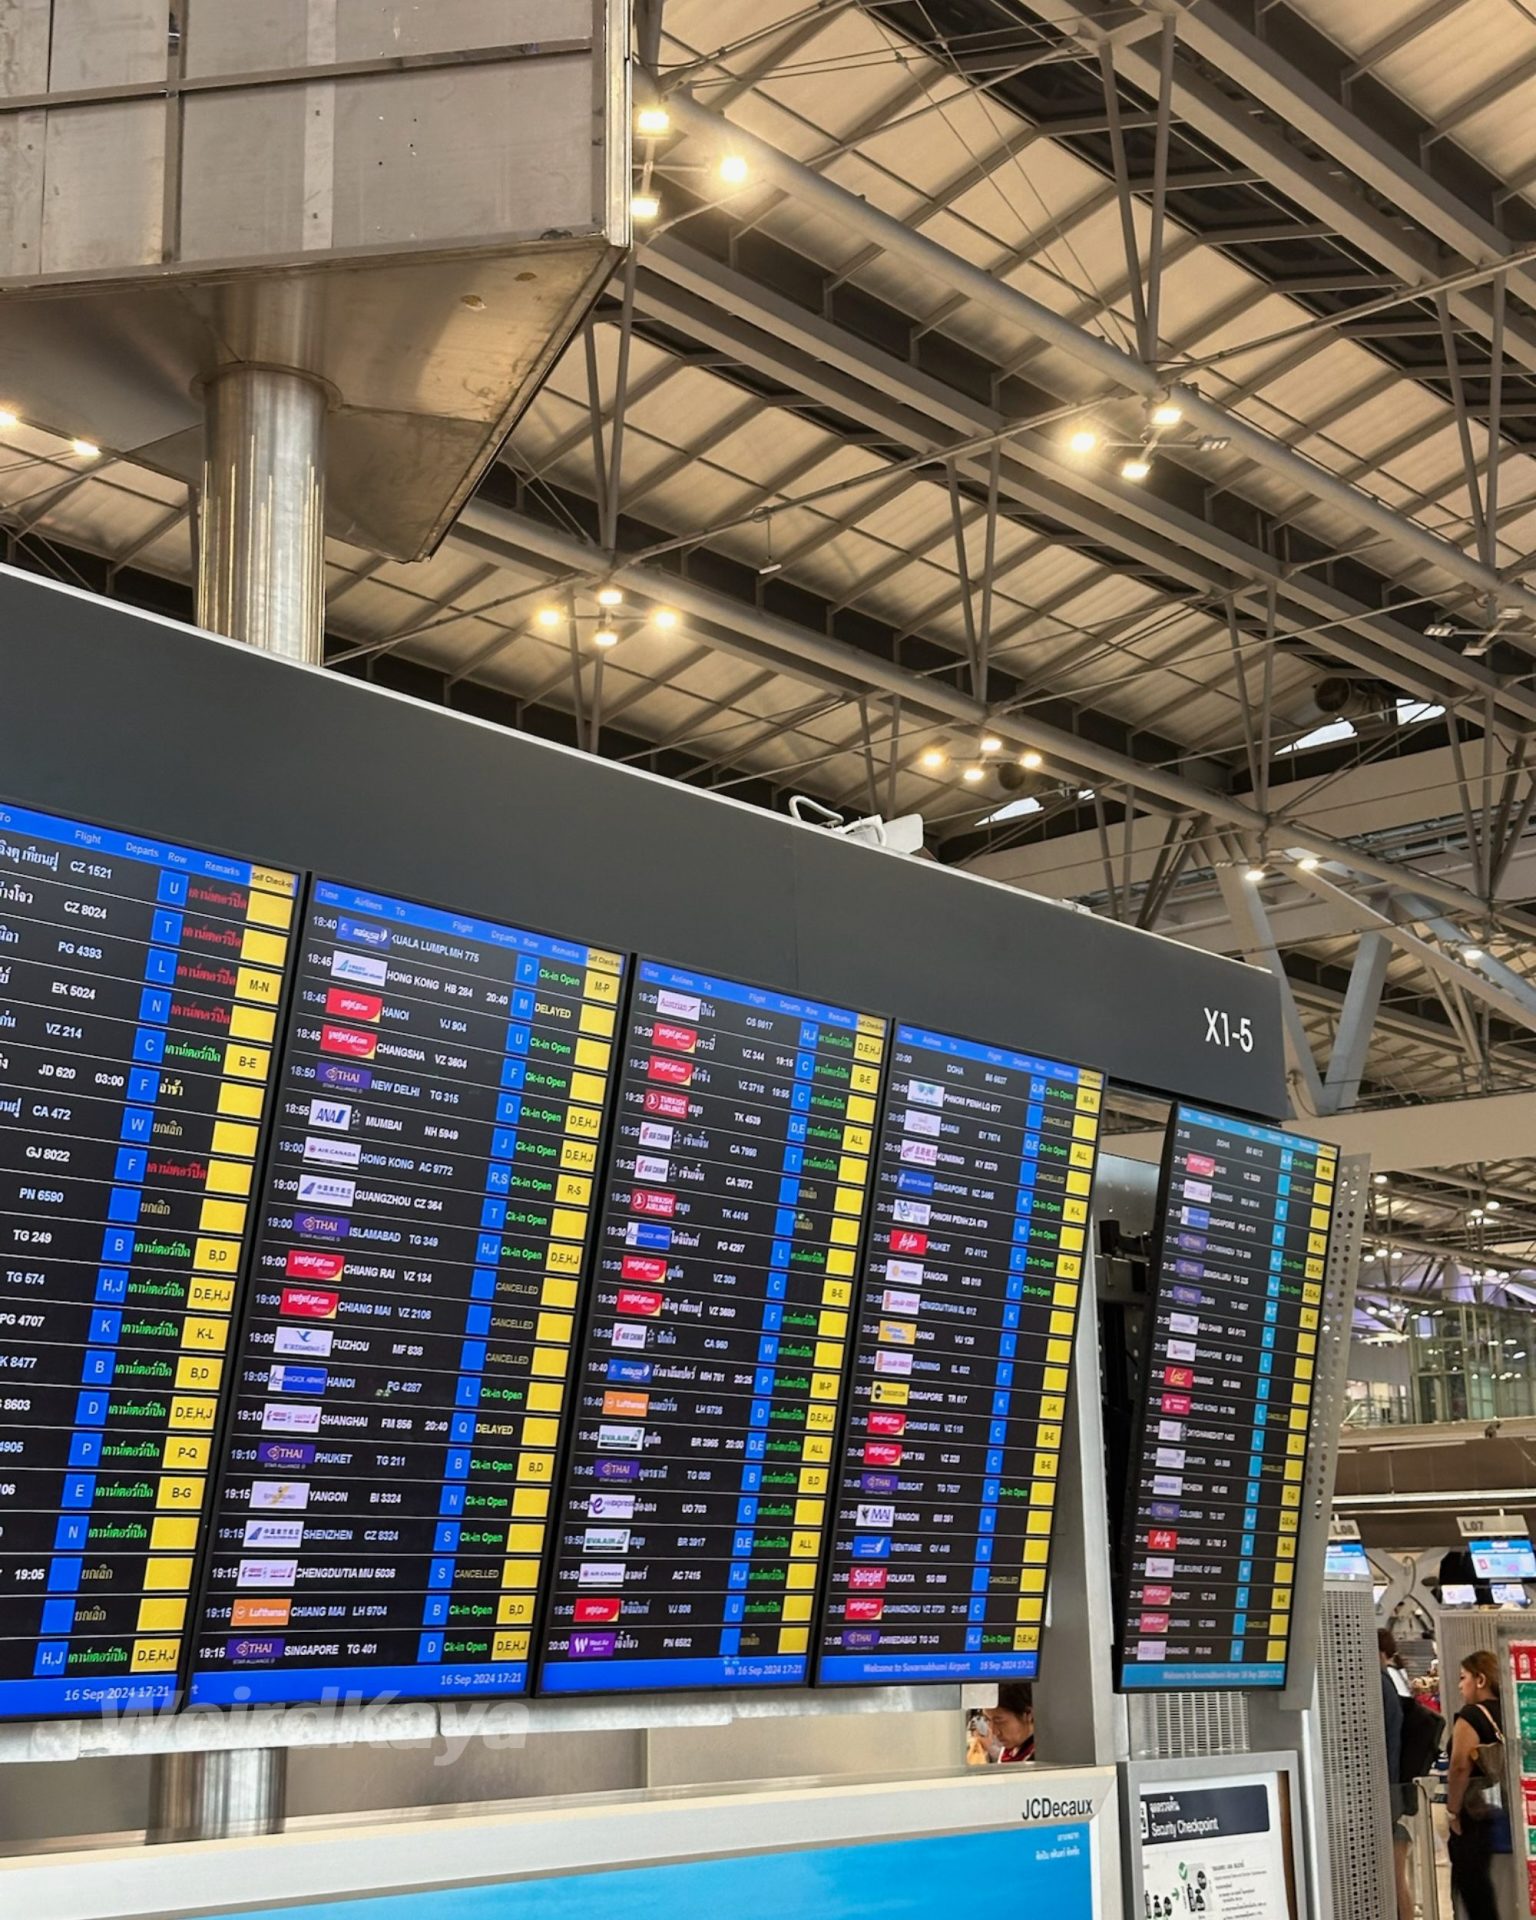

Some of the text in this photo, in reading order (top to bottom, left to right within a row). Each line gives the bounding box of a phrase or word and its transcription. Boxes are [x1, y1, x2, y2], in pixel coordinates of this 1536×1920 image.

[75, 830, 101, 844] Flight
[126, 842, 160, 859] Departs
[168, 852, 187, 864] Row
[70, 860, 112, 880] CZ 1521
[205, 861, 240, 877] Remarks
[170, 882, 178, 894] U
[64, 902, 107, 920] CZ 8024
[313, 916, 337, 930] 18:40
[58, 942, 102, 959] PG 4393
[158, 961, 166, 972] L
[308, 954, 332, 966] 18:45
[250, 980, 270, 993] M-N
[387, 971, 412, 984] HONG
[414, 977, 439, 990] KONG
[52, 982, 96, 1000] EK 5024
[302, 991, 326, 1003] 18:45
[152, 1000, 161, 1012] N
[535, 1003, 571, 1018] DELAYED
[382, 1007, 409, 1020] HANOI
[46, 1022, 82, 1039] VZ 214
[297, 1028, 321, 1041] 18:45
[1204, 1007, 1254, 1053] X1-5
[145, 1040, 154, 1051] C
[377, 1043, 425, 1061] CHANGSHA
[239, 1056, 256, 1069] B-E
[38, 1064, 76, 1080] JD 620
[291, 1066, 315, 1078] 18:50
[338, 1071, 360, 1083] THAI
[95, 1072, 124, 1087] 03:00
[371, 1080, 392, 1092] NEW
[394, 1083, 420, 1097] DELHI
[430, 1090, 459, 1103] TG 315
[33, 1106, 71, 1120] CA 472
[285, 1103, 309, 1116] 18:55
[316, 1108, 338, 1122] ANA
[131, 1120, 145, 1131] W
[365, 1116, 402, 1130] MUMBAI
[851, 1134, 863, 1145] ALL
[279, 1141, 304, 1153] 19:00
[26, 1147, 70, 1163] GJ 8022
[361, 1153, 414, 1170] HONG KONG
[418, 1163, 432, 1173] AC
[273, 1179, 298, 1191] 19:00
[19, 1188, 63, 1203] PN 6590
[355, 1190, 411, 1206] GUANGZHOU
[267, 1217, 292, 1229] 19:00
[315, 1219, 338, 1231] THAI
[13, 1230, 52, 1244] TG 249
[350, 1227, 401, 1242] ISLAMABAD
[409, 1235, 421, 1244] TG
[115, 1239, 124, 1251] B
[209, 1250, 227, 1262] B,D
[261, 1255, 286, 1267] 19:00
[7, 1271, 45, 1285] TG 574
[344, 1265, 395, 1279] CHIANG RAI
[404, 1271, 432, 1283] VZ 134
[103, 1279, 123, 1293] H,J
[496, 1282, 539, 1295] CANCELLED
[194, 1289, 230, 1302] D,E,H,J
[338, 1303, 391, 1316] CHIANG MAI
[0, 1314, 45, 1327] PG 4707
[101, 1320, 110, 1332] K
[197, 1328, 214, 1340] K-L
[249, 1332, 275, 1344] 19:05
[332, 1339, 370, 1352] FUZHOU
[10, 1357, 37, 1369] 8477
[95, 1362, 104, 1373] B
[191, 1368, 209, 1380] B,D
[327, 1377, 355, 1388] HANOI
[4, 1399, 30, 1411] 8603
[89, 1402, 98, 1414] D
[176, 1407, 212, 1420] D,E,H,J
[237, 1410, 263, 1421] 19:10
[321, 1414, 368, 1427] SHANGHAI
[475, 1423, 513, 1435] DELAYED
[82, 1443, 92, 1455] P
[178, 1447, 198, 1459] P-Q
[279, 1447, 304, 1459] THAI
[314, 1452, 353, 1464] PHUKET
[377, 1455, 389, 1465] TG
[75, 1484, 84, 1497] E
[172, 1488, 192, 1498] B-G
[224, 1489, 251, 1500] 19:15
[309, 1492, 348, 1502] YANGON
[69, 1527, 78, 1538] N
[1463, 1521, 1484, 1531] L07
[303, 1529, 353, 1540] SHENZHEN
[14, 1569, 45, 1580] 19:05
[454, 1569, 499, 1579] CANCELLED
[249, 1607, 287, 1617] Lufthansa
[291, 1606, 346, 1617] CHIANG MAI
[199, 1646, 225, 1659] 19:15
[248, 1642, 273, 1654] THAI
[284, 1643, 339, 1656] SINGAPORE
[347, 1643, 377, 1654] TG 401
[42, 1652, 64, 1666] H,J
[137, 1650, 176, 1663] D,E,H,J
[440, 1672, 521, 1687] 16 Sep 2024 17:21
[65, 1686, 169, 1703] 16 Sep 2024 17:21
[1022, 1798, 1093, 1820] JCDecaux
[1152, 1817, 1219, 1838] Security Checkpoint
